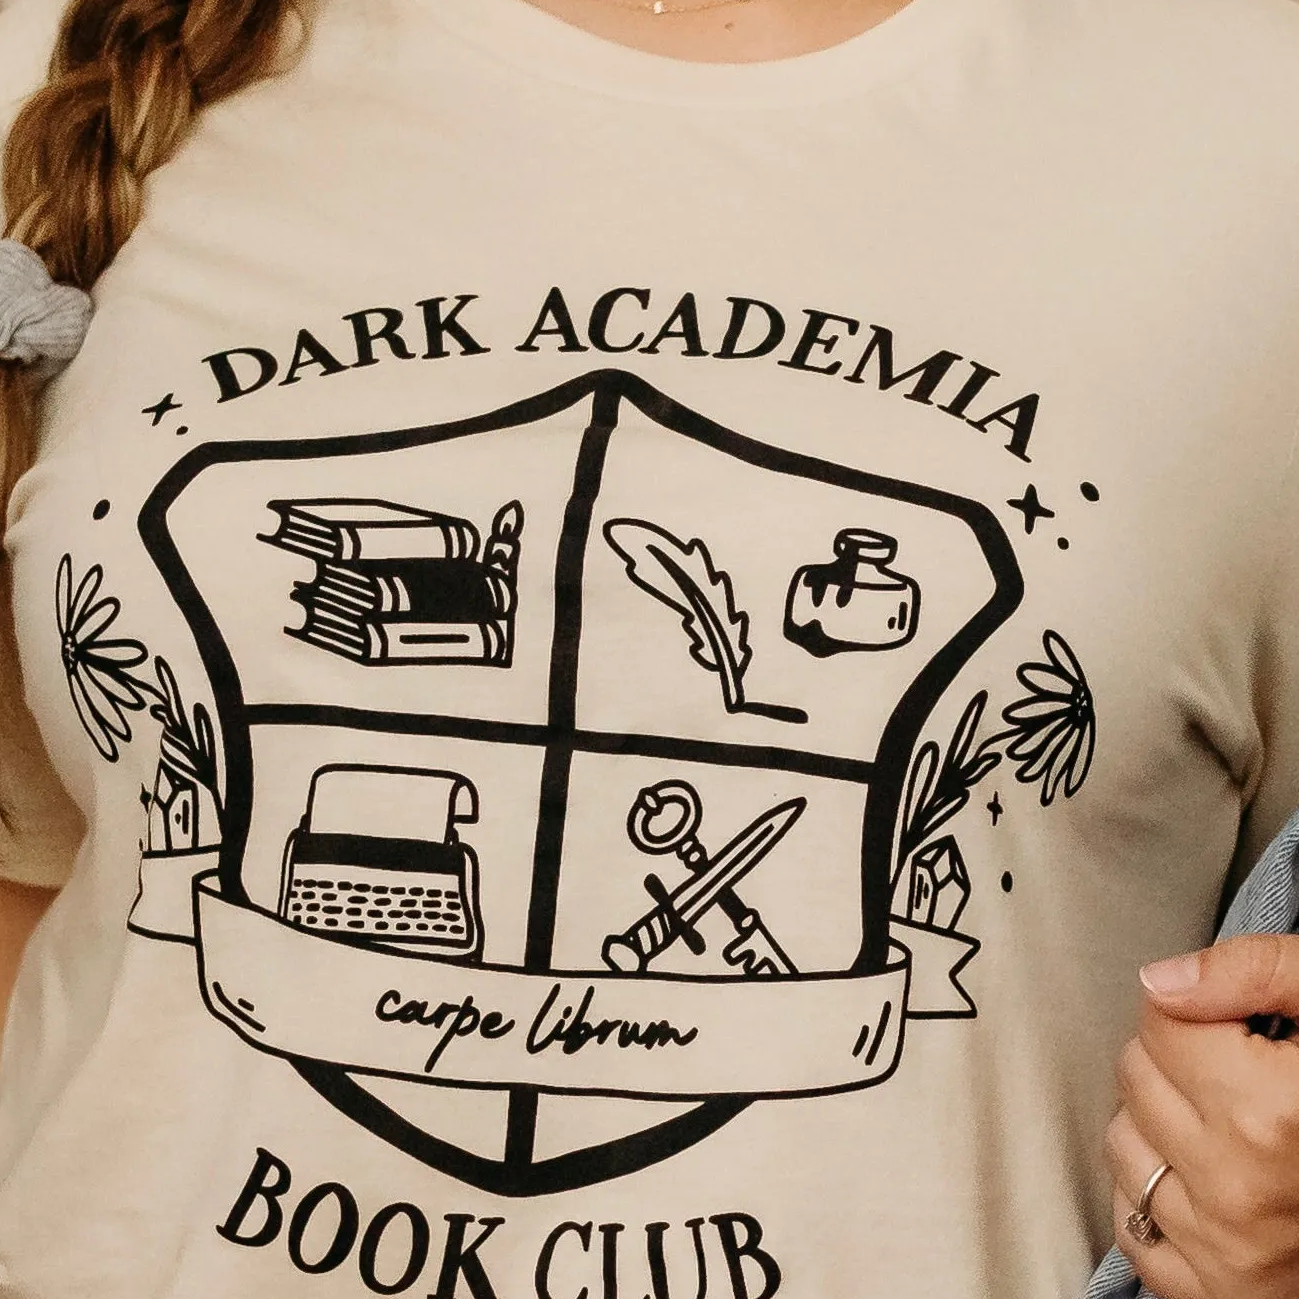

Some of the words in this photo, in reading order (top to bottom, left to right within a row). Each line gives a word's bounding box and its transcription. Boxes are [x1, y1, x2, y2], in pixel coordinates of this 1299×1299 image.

[201, 294, 492, 404] DARK
[514, 286, 1040, 464] ACADEMIA
[374, 989, 516, 1074] carpe
[525, 983, 699, 1055] librum
